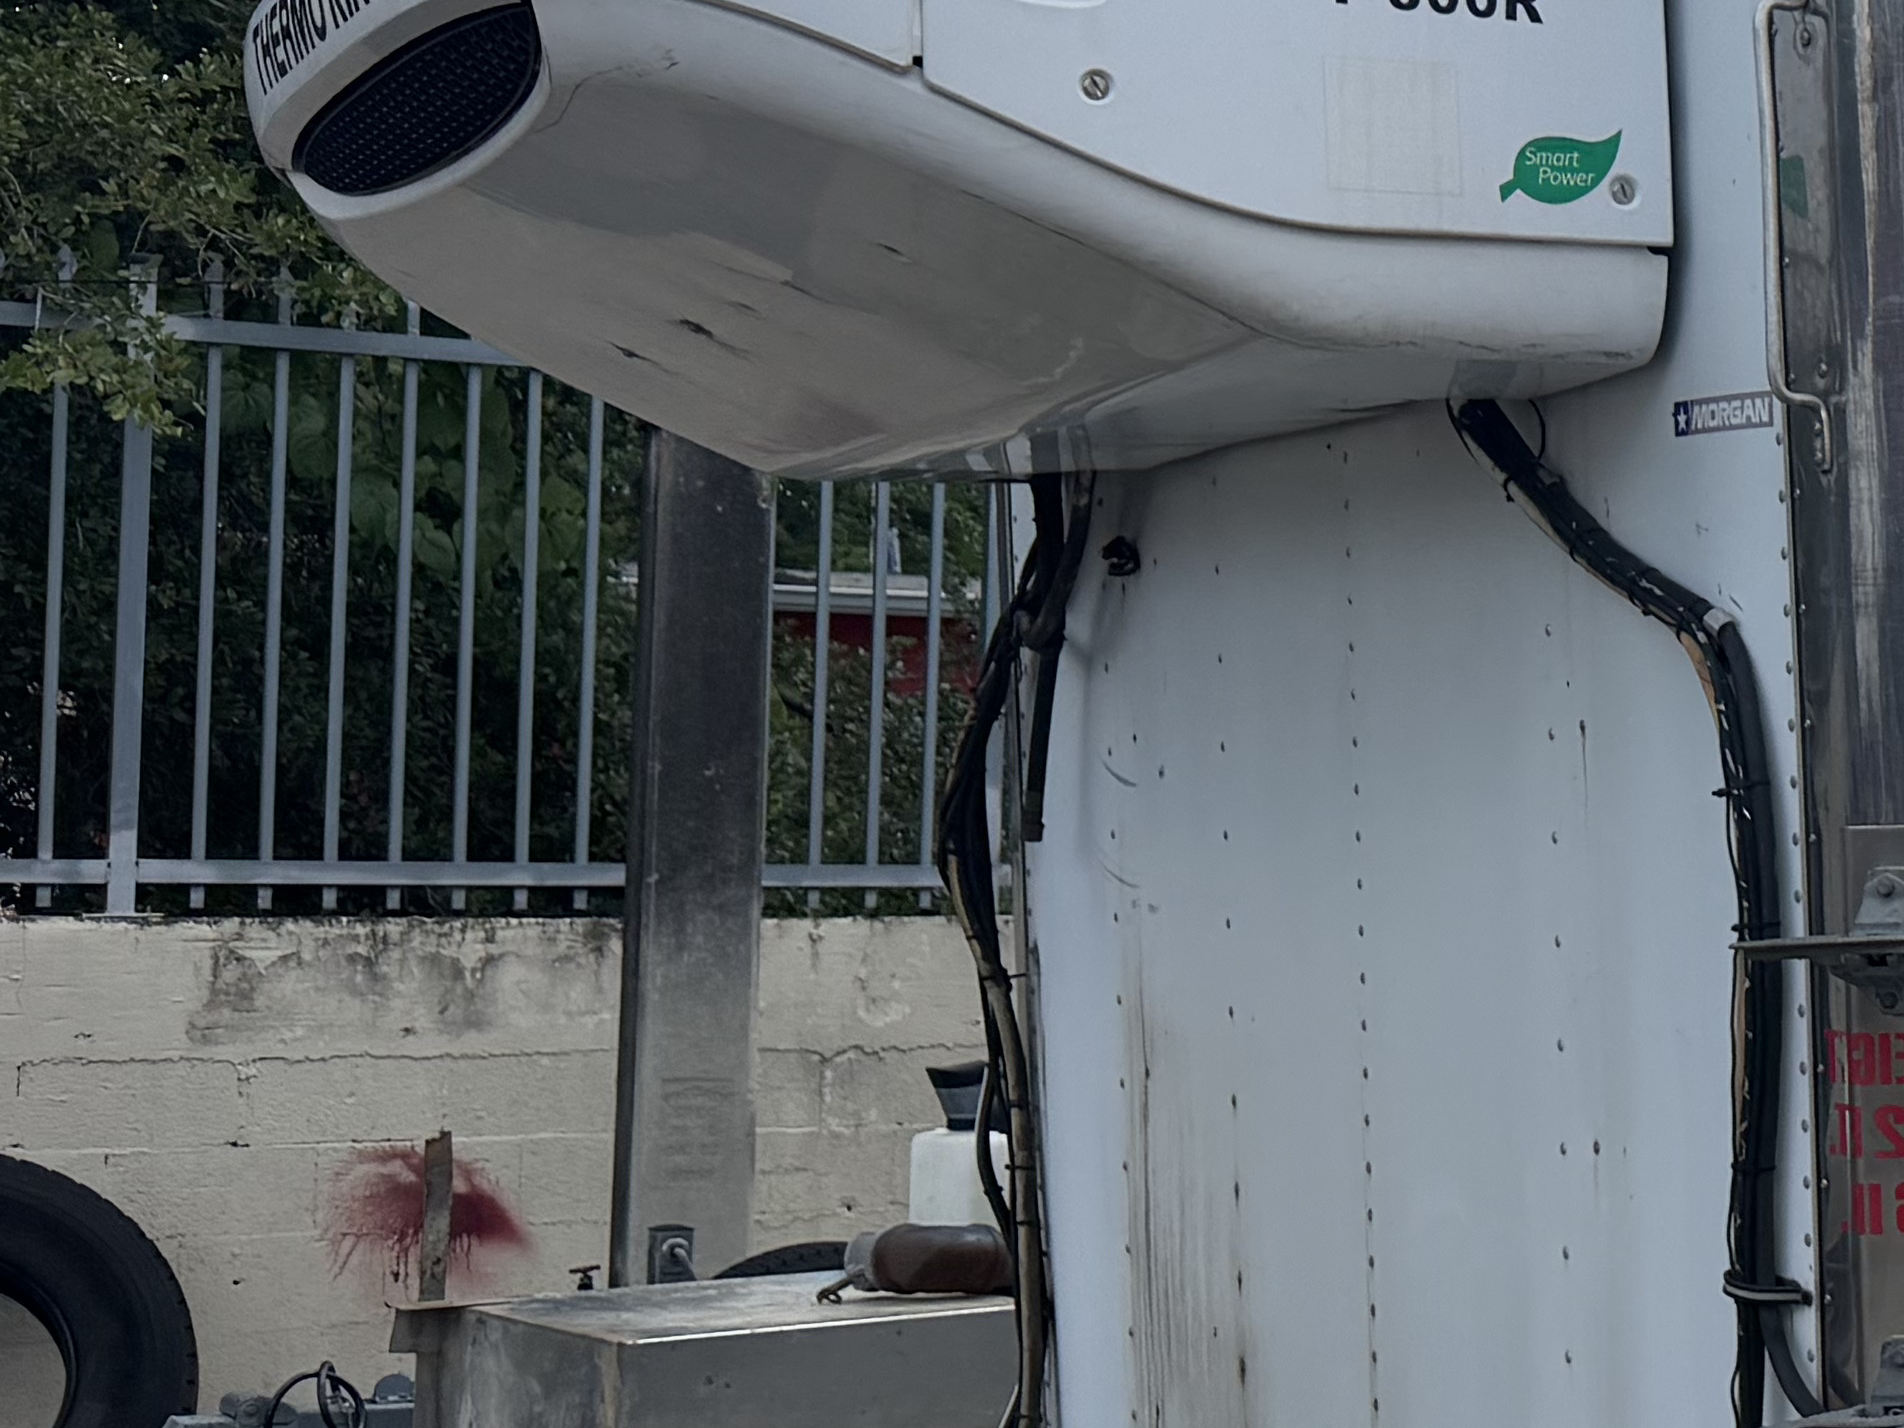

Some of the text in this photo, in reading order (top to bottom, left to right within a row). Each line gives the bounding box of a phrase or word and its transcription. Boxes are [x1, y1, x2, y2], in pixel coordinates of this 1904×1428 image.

[1525, 147, 1580, 168] Smart
[1538, 167, 1596, 187] Power
[1690, 396, 1771, 430] MORGAN
